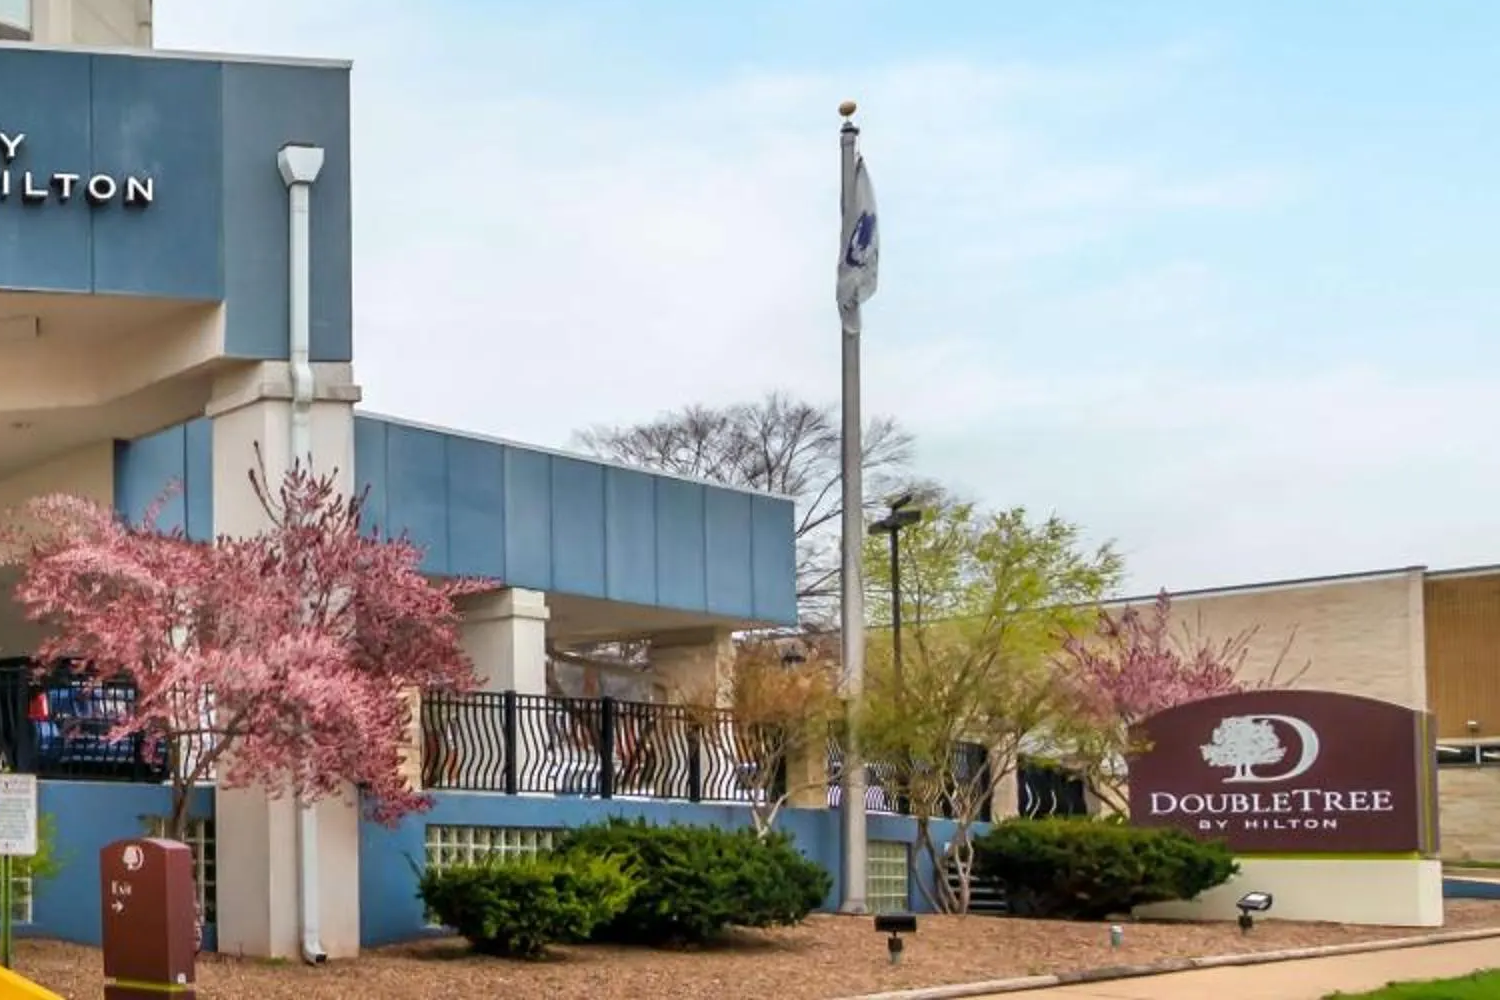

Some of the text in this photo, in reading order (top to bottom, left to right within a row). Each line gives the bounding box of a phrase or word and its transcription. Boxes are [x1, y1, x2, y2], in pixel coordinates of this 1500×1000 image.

[1151, 788, 1393, 815] DOUBLETREE
[1198, 818, 1338, 830] BY HILTON
